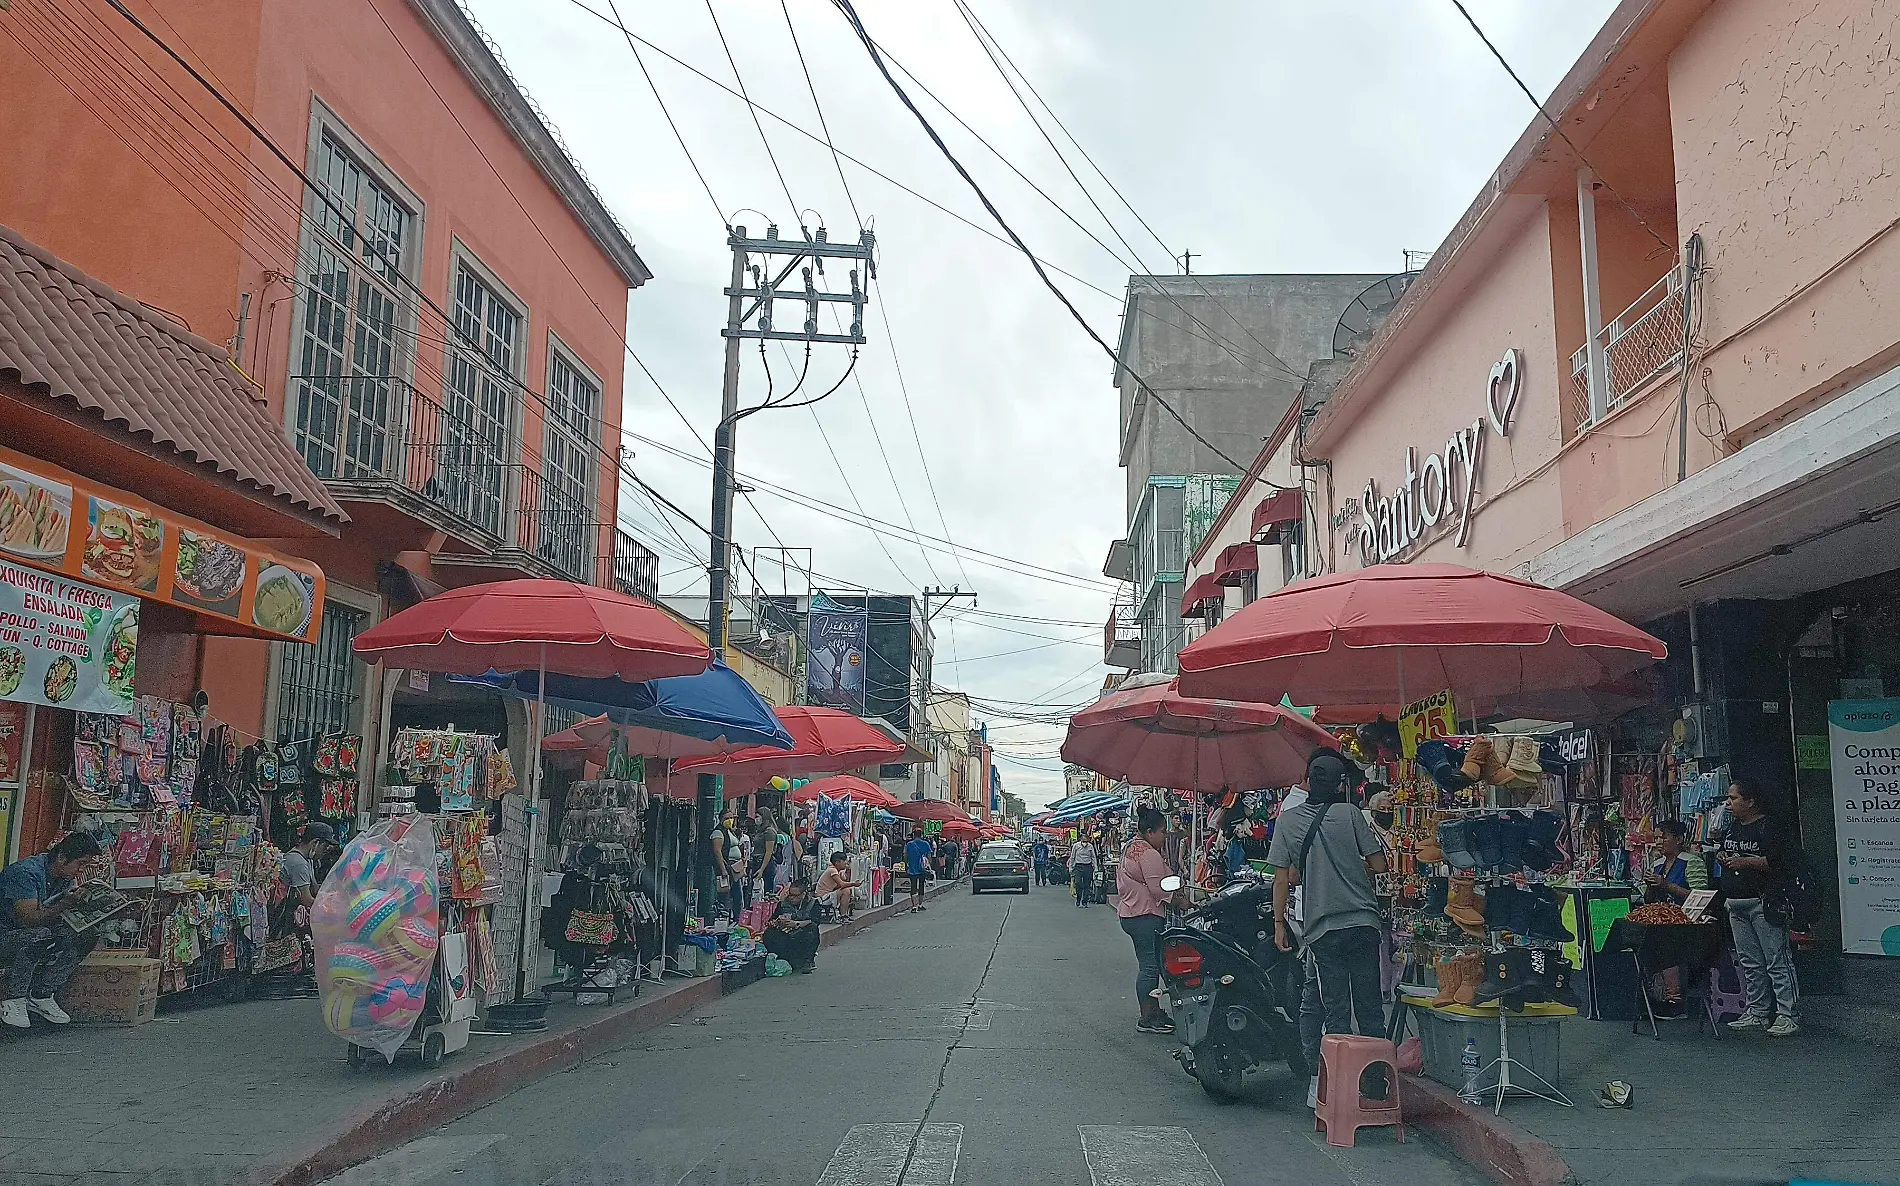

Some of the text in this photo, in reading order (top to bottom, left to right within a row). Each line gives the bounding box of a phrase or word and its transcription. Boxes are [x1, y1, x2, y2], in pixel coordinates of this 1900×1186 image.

[1359, 416, 1486, 567] Santory
[23, 592, 85, 622] ENSALADA
[57, 582, 68, 599] Y
[67, 586, 113, 610] FRESCA
[0, 612, 37, 629] POLLO
[47, 621, 87, 641] SALMÓN
[32, 635, 43, 648] Q.
[46, 637, 89, 657] COTTAGE
[1399, 690, 1447, 720] LLAVEROS
[1844, 712, 1878, 722] aplazo
[1414, 707, 1447, 746] 25
[1559, 731, 1587, 762] telcel
[1844, 744, 1900, 760] Comp
[1845, 799, 1857, 810] a
[1846, 815, 1860, 823] Sin
[1861, 815, 1889, 824] tarjeta
